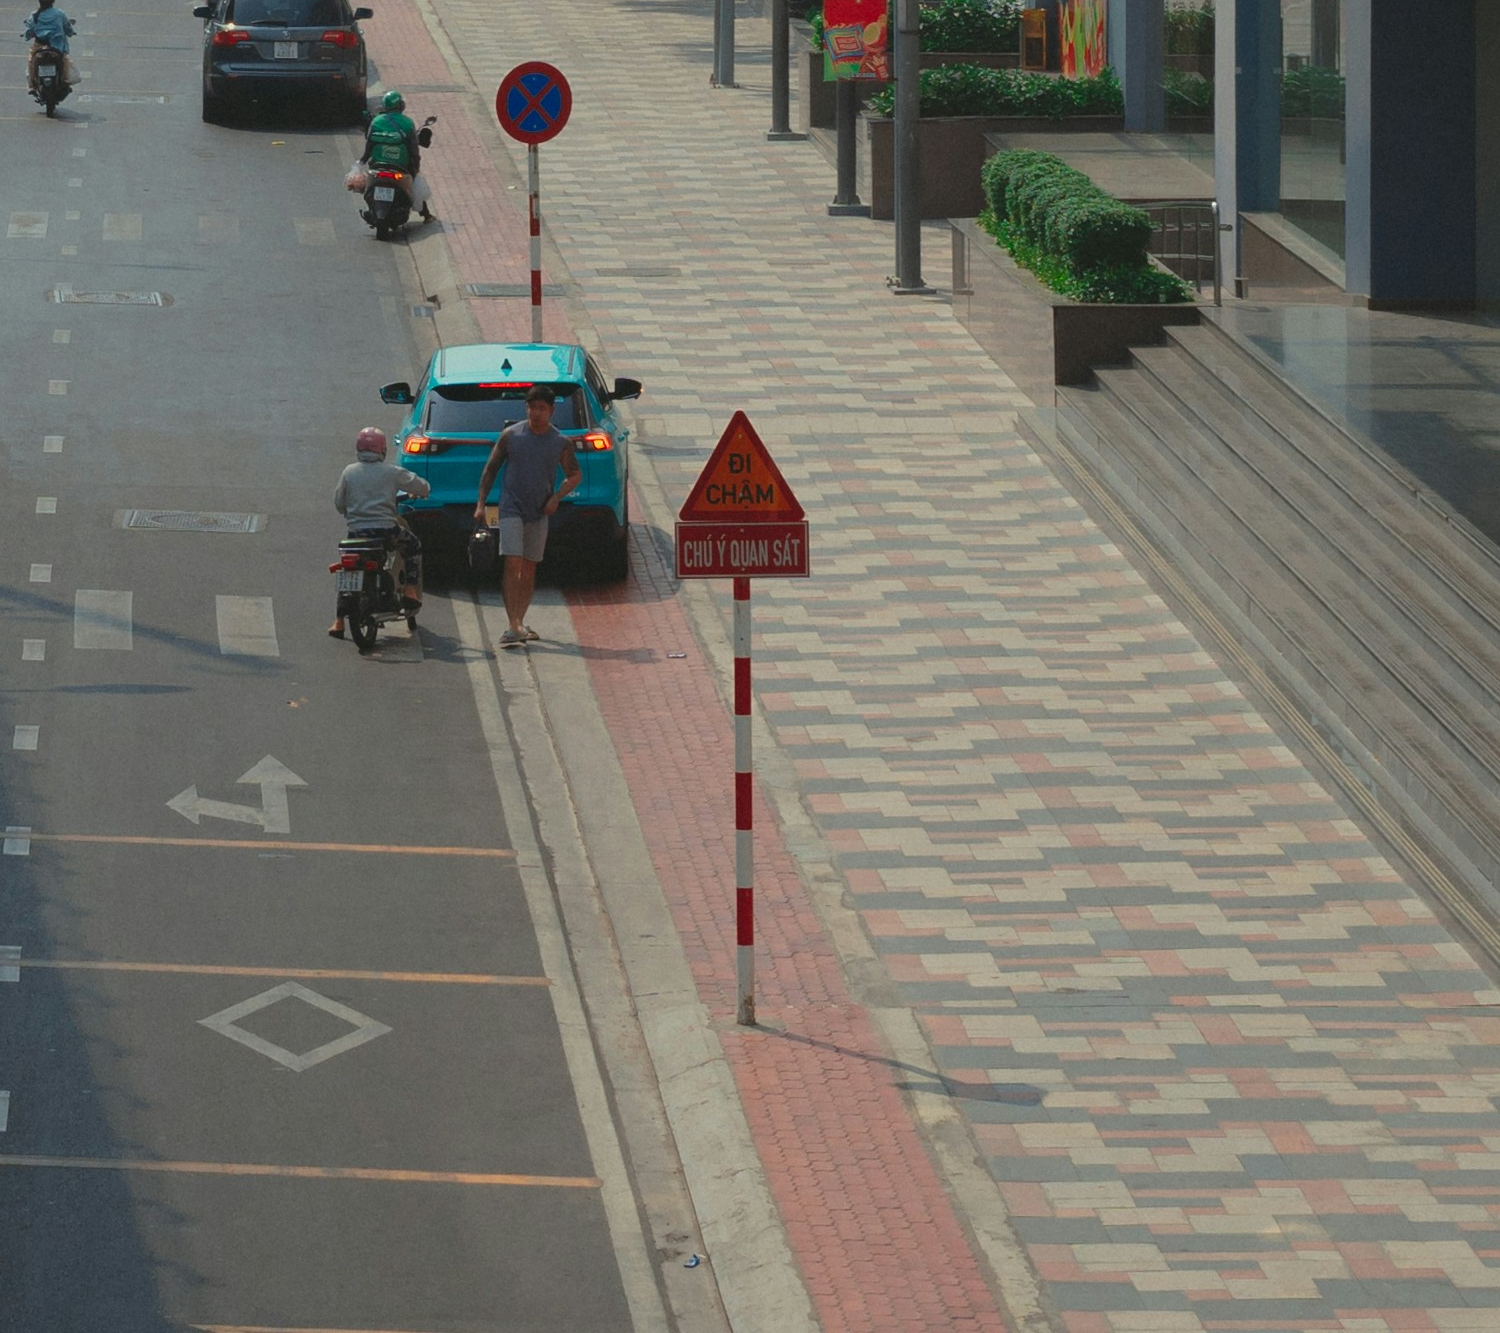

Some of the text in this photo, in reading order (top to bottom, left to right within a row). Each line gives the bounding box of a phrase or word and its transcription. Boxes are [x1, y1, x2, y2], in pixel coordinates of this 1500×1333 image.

[727, 453, 750, 474] ĐI
[706, 479, 774, 509] CHẬM
[684, 533, 801, 568] CHÚ Ý QUAN SÁT
